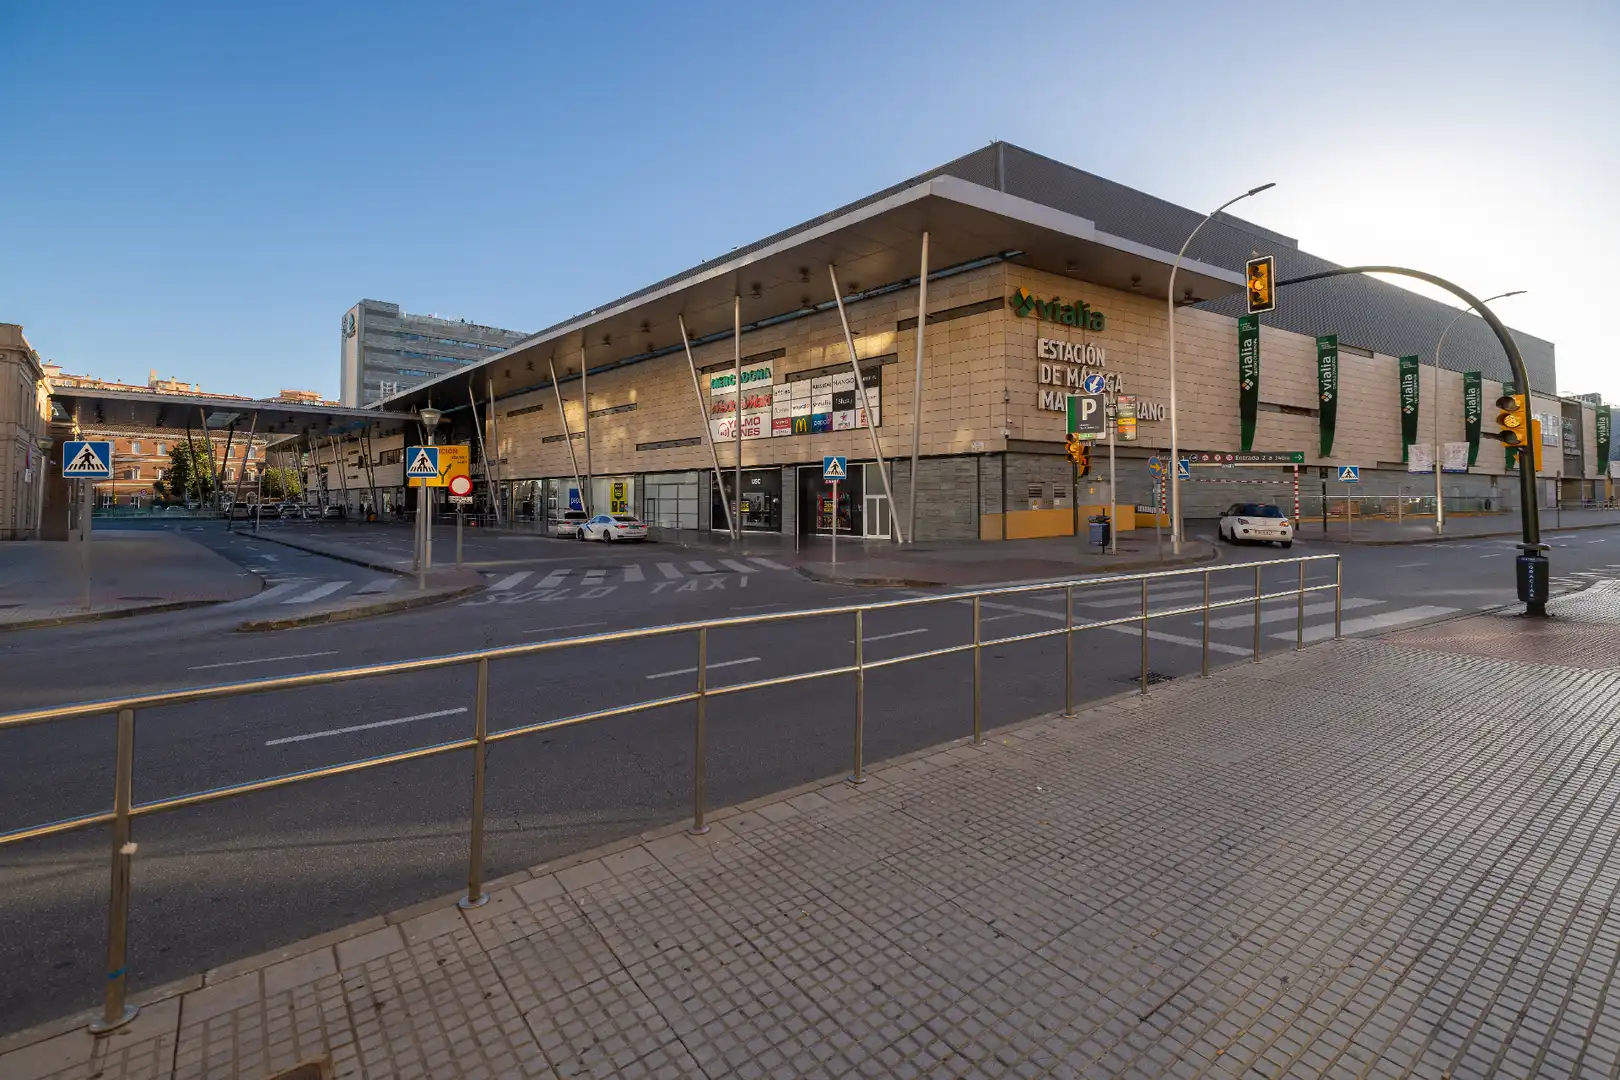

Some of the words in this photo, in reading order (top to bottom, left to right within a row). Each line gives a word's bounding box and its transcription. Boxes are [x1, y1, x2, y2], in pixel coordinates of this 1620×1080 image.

[1036, 297, 1106, 332] vialia
[1038, 338, 1106, 367] ESTACIÓN
[1241, 338, 1252, 377] vialia
[1039, 363, 1065, 386] DE
[1320, 356, 1332, 390] vialia
[1402, 374, 1414, 404] vialia
[1466, 387, 1476, 415] vialia
[1082, 398, 1097, 421] P
[650, 575, 749, 595] TAXI
